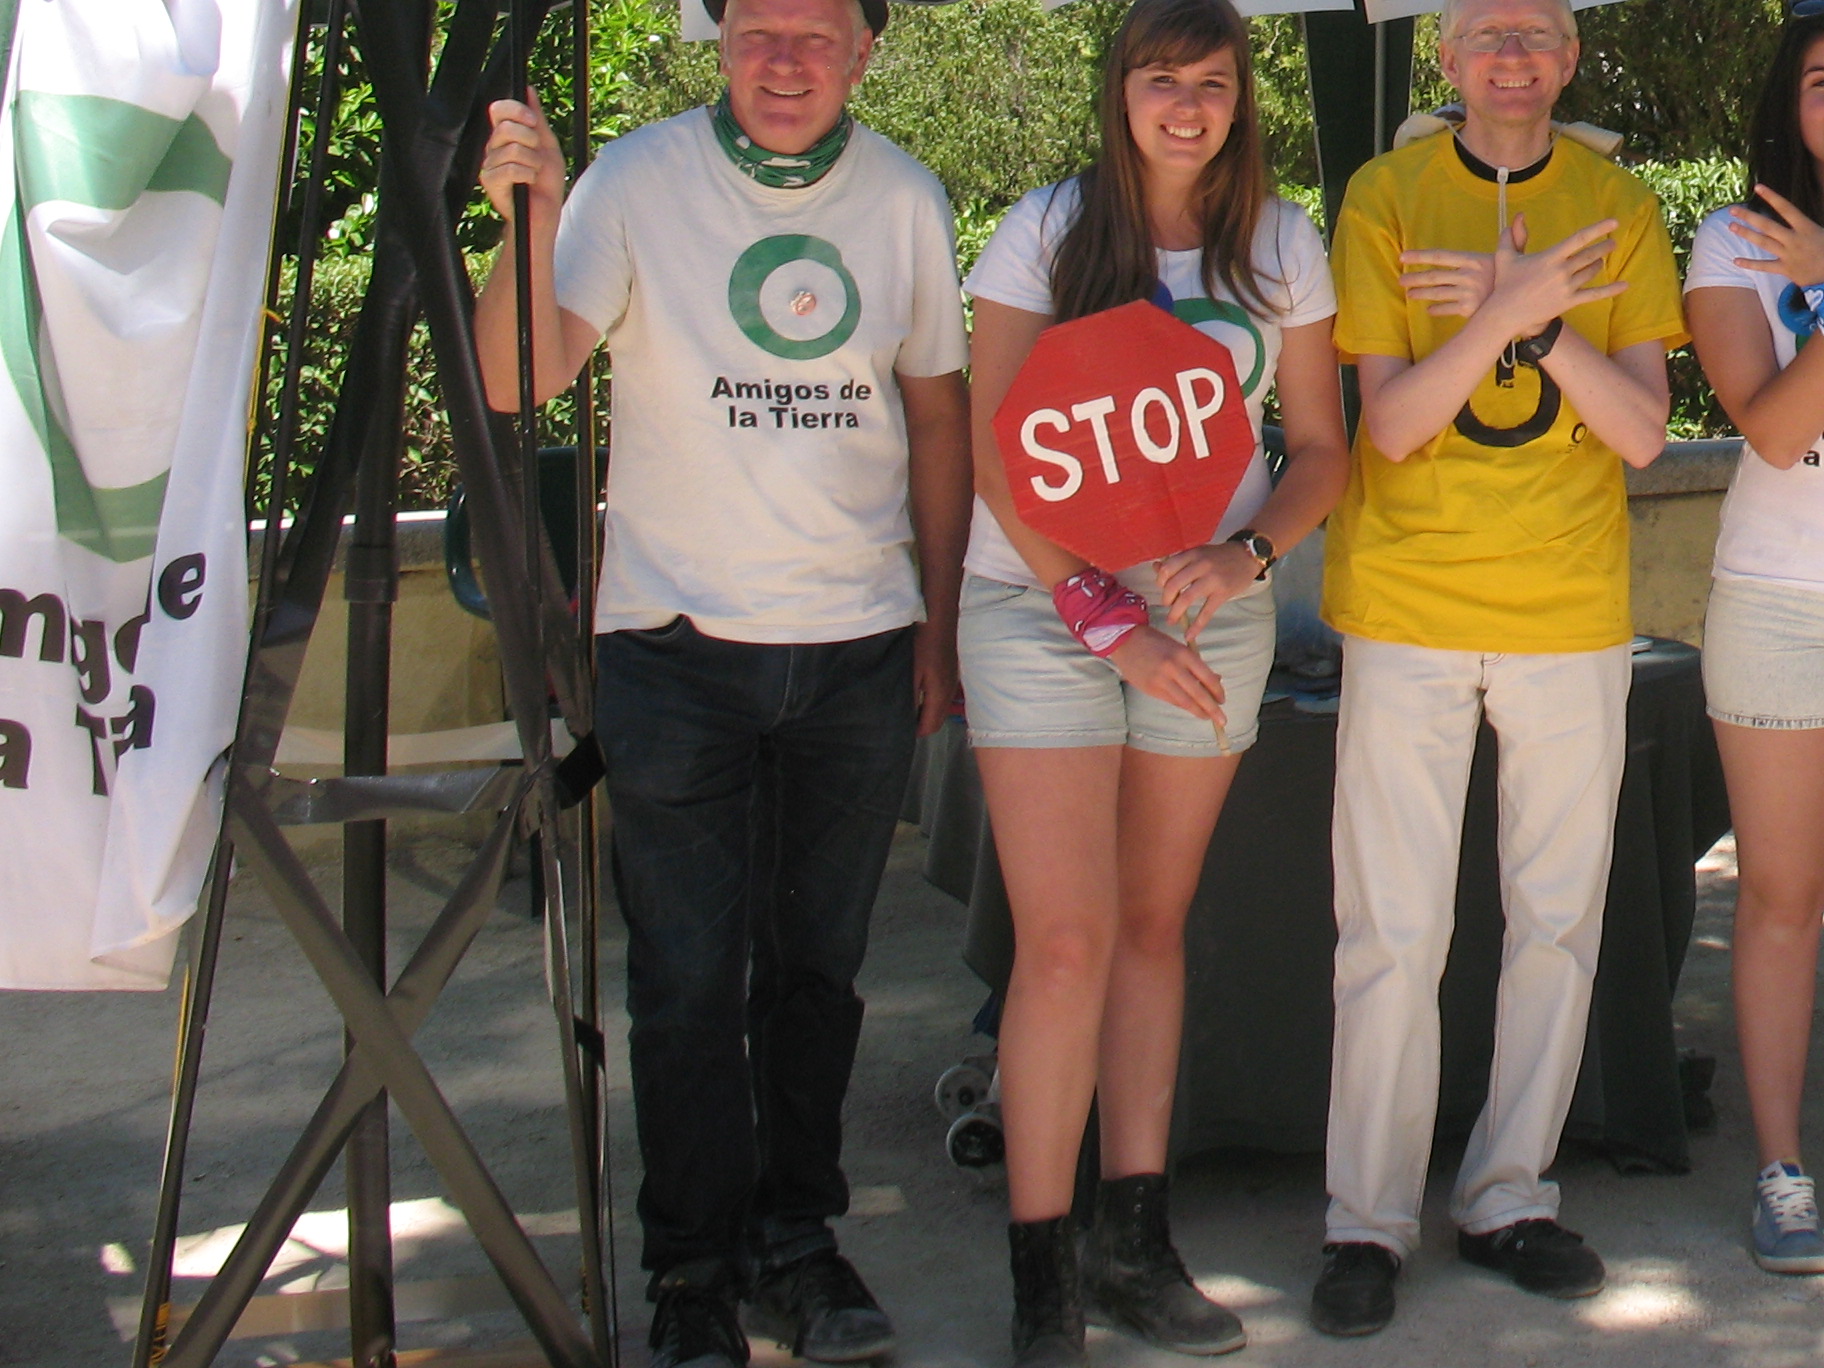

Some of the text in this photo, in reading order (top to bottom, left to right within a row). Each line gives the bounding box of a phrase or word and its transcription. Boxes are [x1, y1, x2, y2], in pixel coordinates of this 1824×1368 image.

[711, 376, 872, 405] Amigos de
[729, 405, 859, 429] la Tierra
[1020, 367, 1225, 503] STOP
